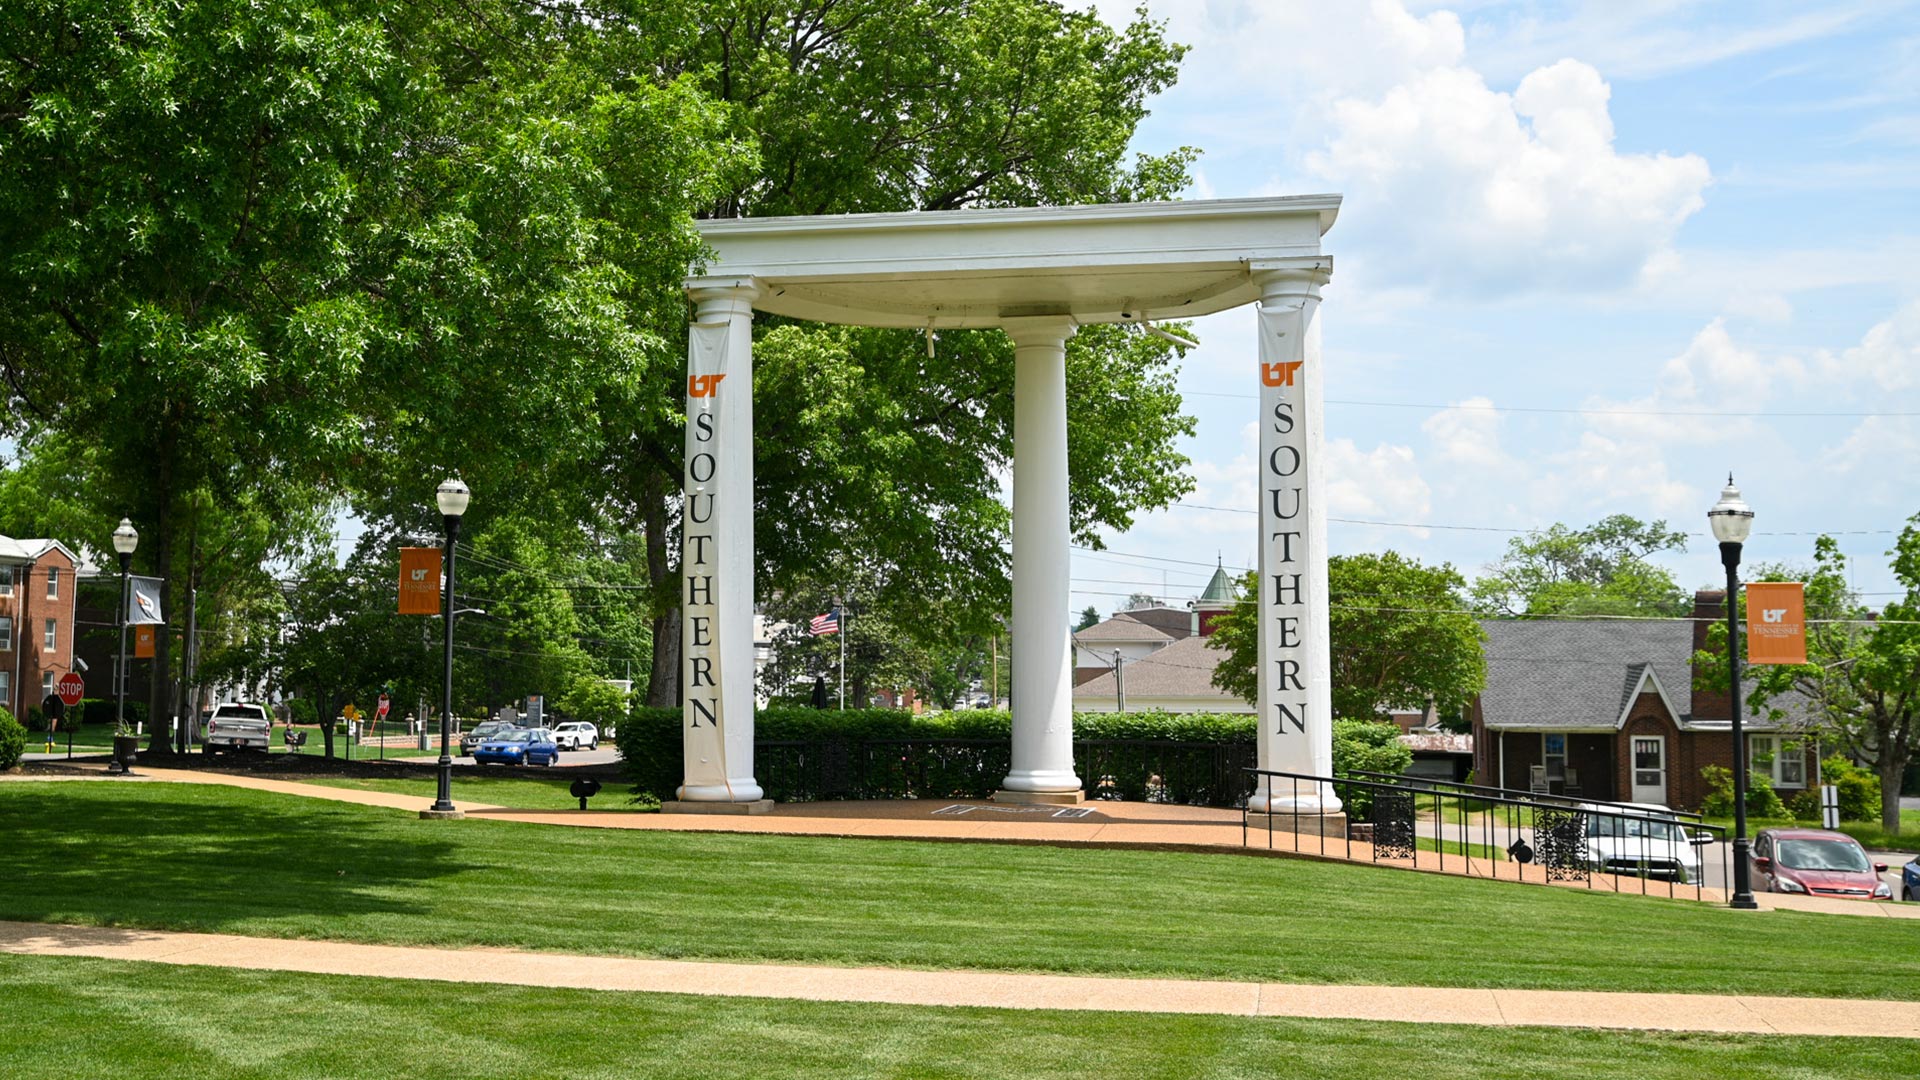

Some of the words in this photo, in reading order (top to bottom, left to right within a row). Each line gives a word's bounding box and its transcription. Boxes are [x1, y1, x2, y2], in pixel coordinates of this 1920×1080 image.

[689, 374, 727, 398] UT
[1262, 361, 1303, 387] UT
[688, 412, 718, 727] SOUTHERN
[1268, 403, 1307, 735] SOUTHERN
[1763, 609, 1787, 623] UT
[1753, 627, 1799, 635] TENNESSEE
[60, 682, 82, 696] STOP
